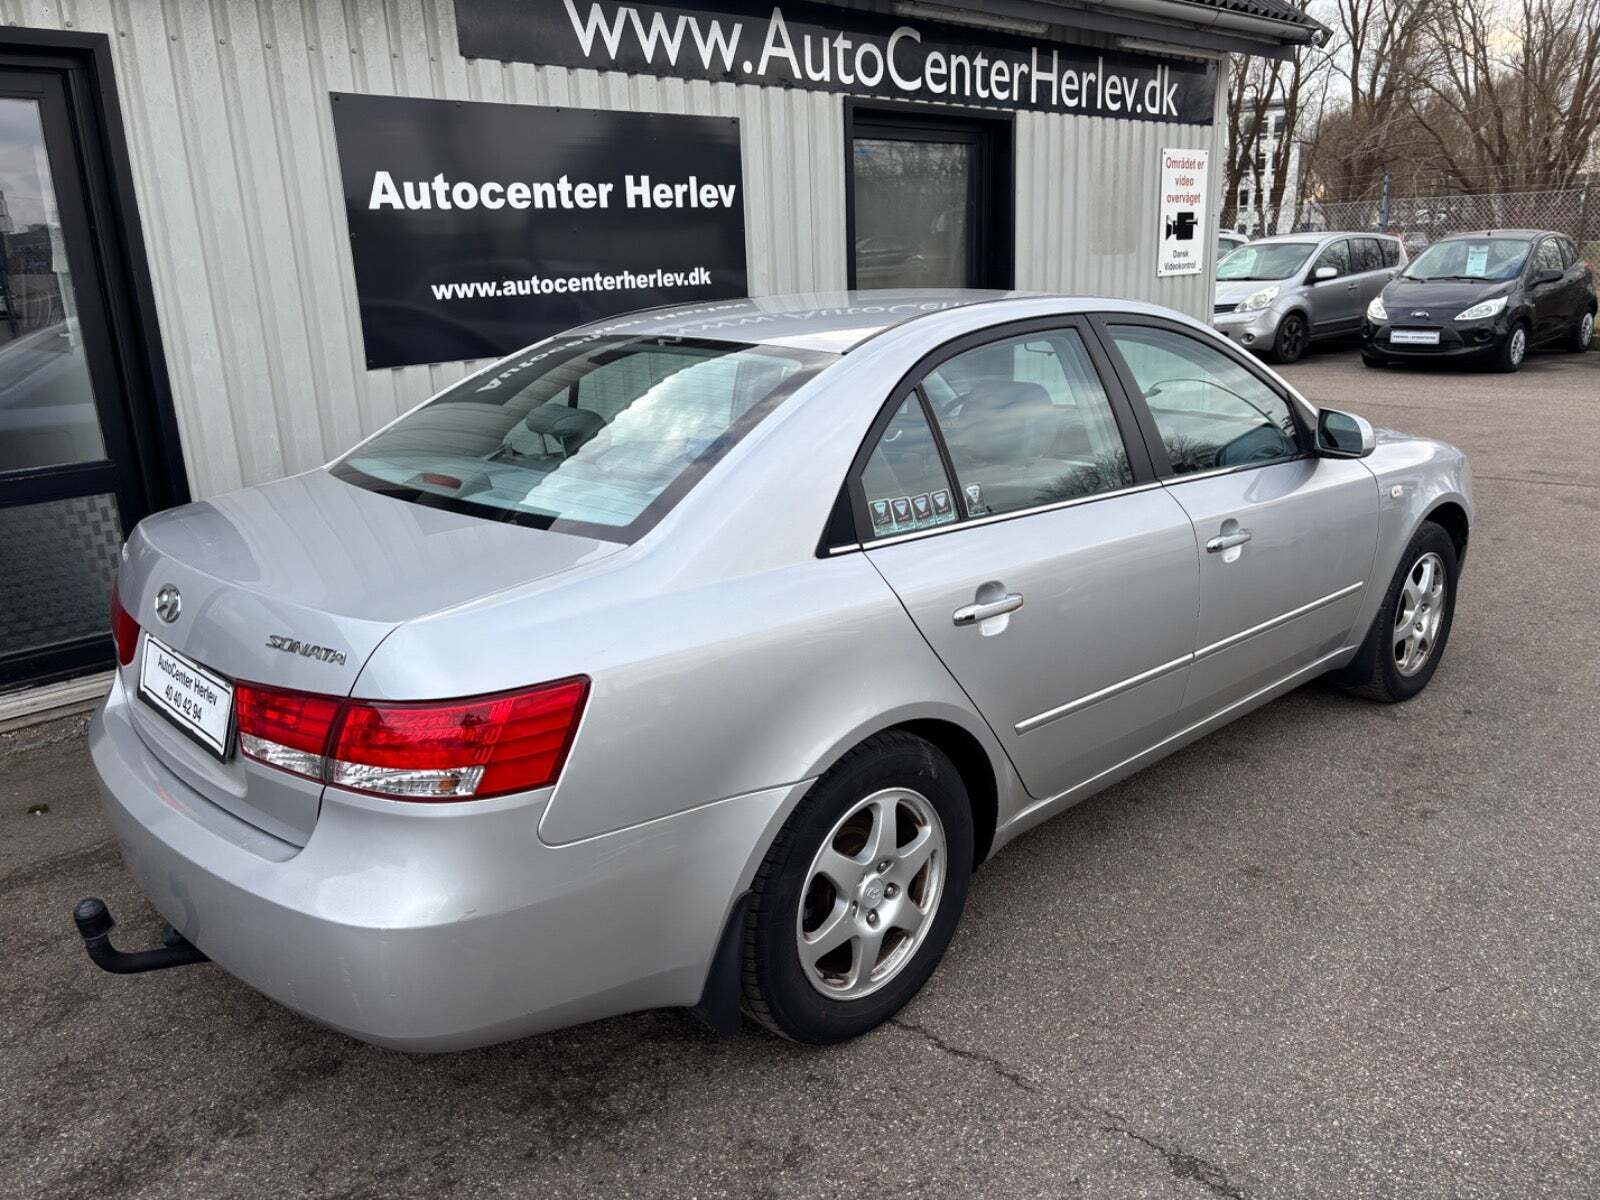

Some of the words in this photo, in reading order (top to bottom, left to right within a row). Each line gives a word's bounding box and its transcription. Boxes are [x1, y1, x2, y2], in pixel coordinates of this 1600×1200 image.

[563, 0, 1178, 117] www.AutoCenterHerlev.dk
[1166, 156, 1196, 170] Området
[1197, 161, 1204, 169] er
[368, 170, 613, 210] Autocenter
[624, 174, 736, 209] Herlev
[1175, 174, 1194, 186] video
[1167, 192, 1200, 206] overvåget
[1164, 261, 1196, 270] Videokontrol
[1173, 250, 1189, 258] Dansk
[431, 267, 712, 300] www.autocenterherlev.dk
[265, 634, 347, 666] SONATA
[158, 654, 193, 688] AutoCenter
[194, 676, 217, 706] Herlev
[165, 684, 173, 701] 40
[173, 691, 182, 708] 40
[182, 697, 192, 715] 42
[193, 703, 203, 722] 94
